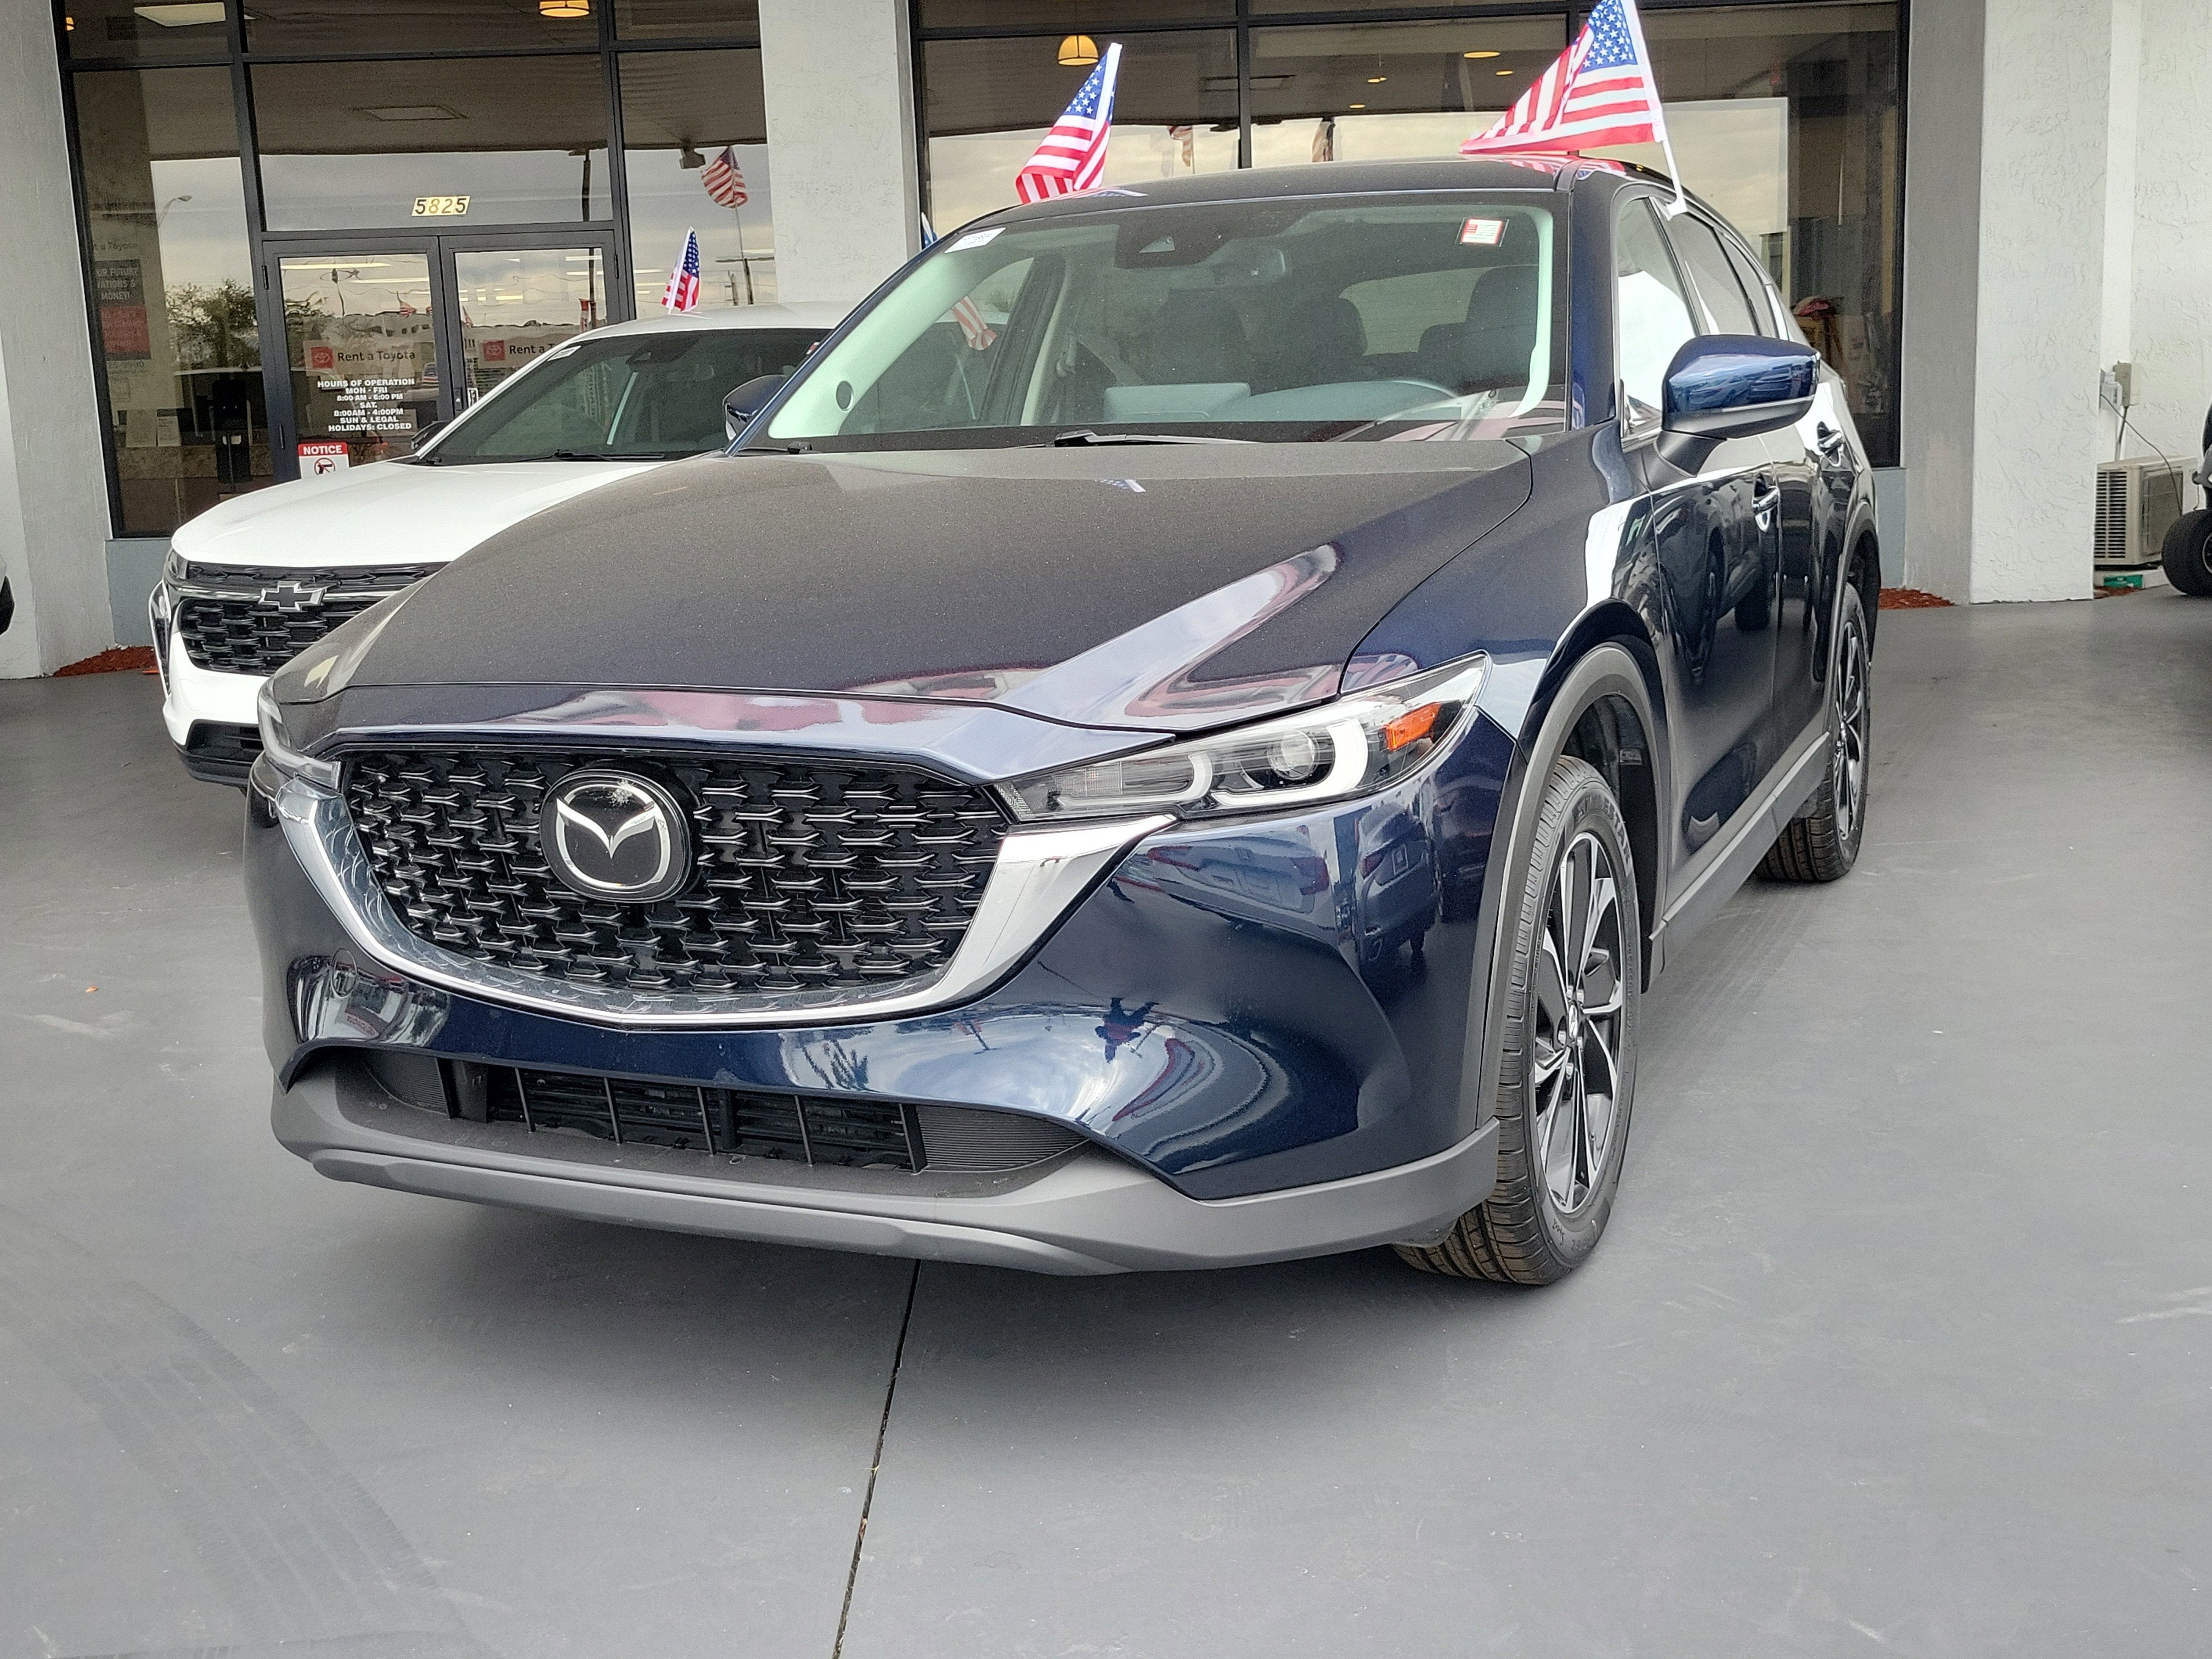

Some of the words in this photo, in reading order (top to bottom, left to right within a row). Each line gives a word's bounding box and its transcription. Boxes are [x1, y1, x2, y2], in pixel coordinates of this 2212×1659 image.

[415, 198, 466, 214] 5825
[509, 345, 536, 354] Rent
[338, 352, 365, 362] Rent
[377, 351, 415, 362] Toyota
[329, 424, 375, 432] HOLIDAYS:
[303, 445, 342, 455] NOTICE
